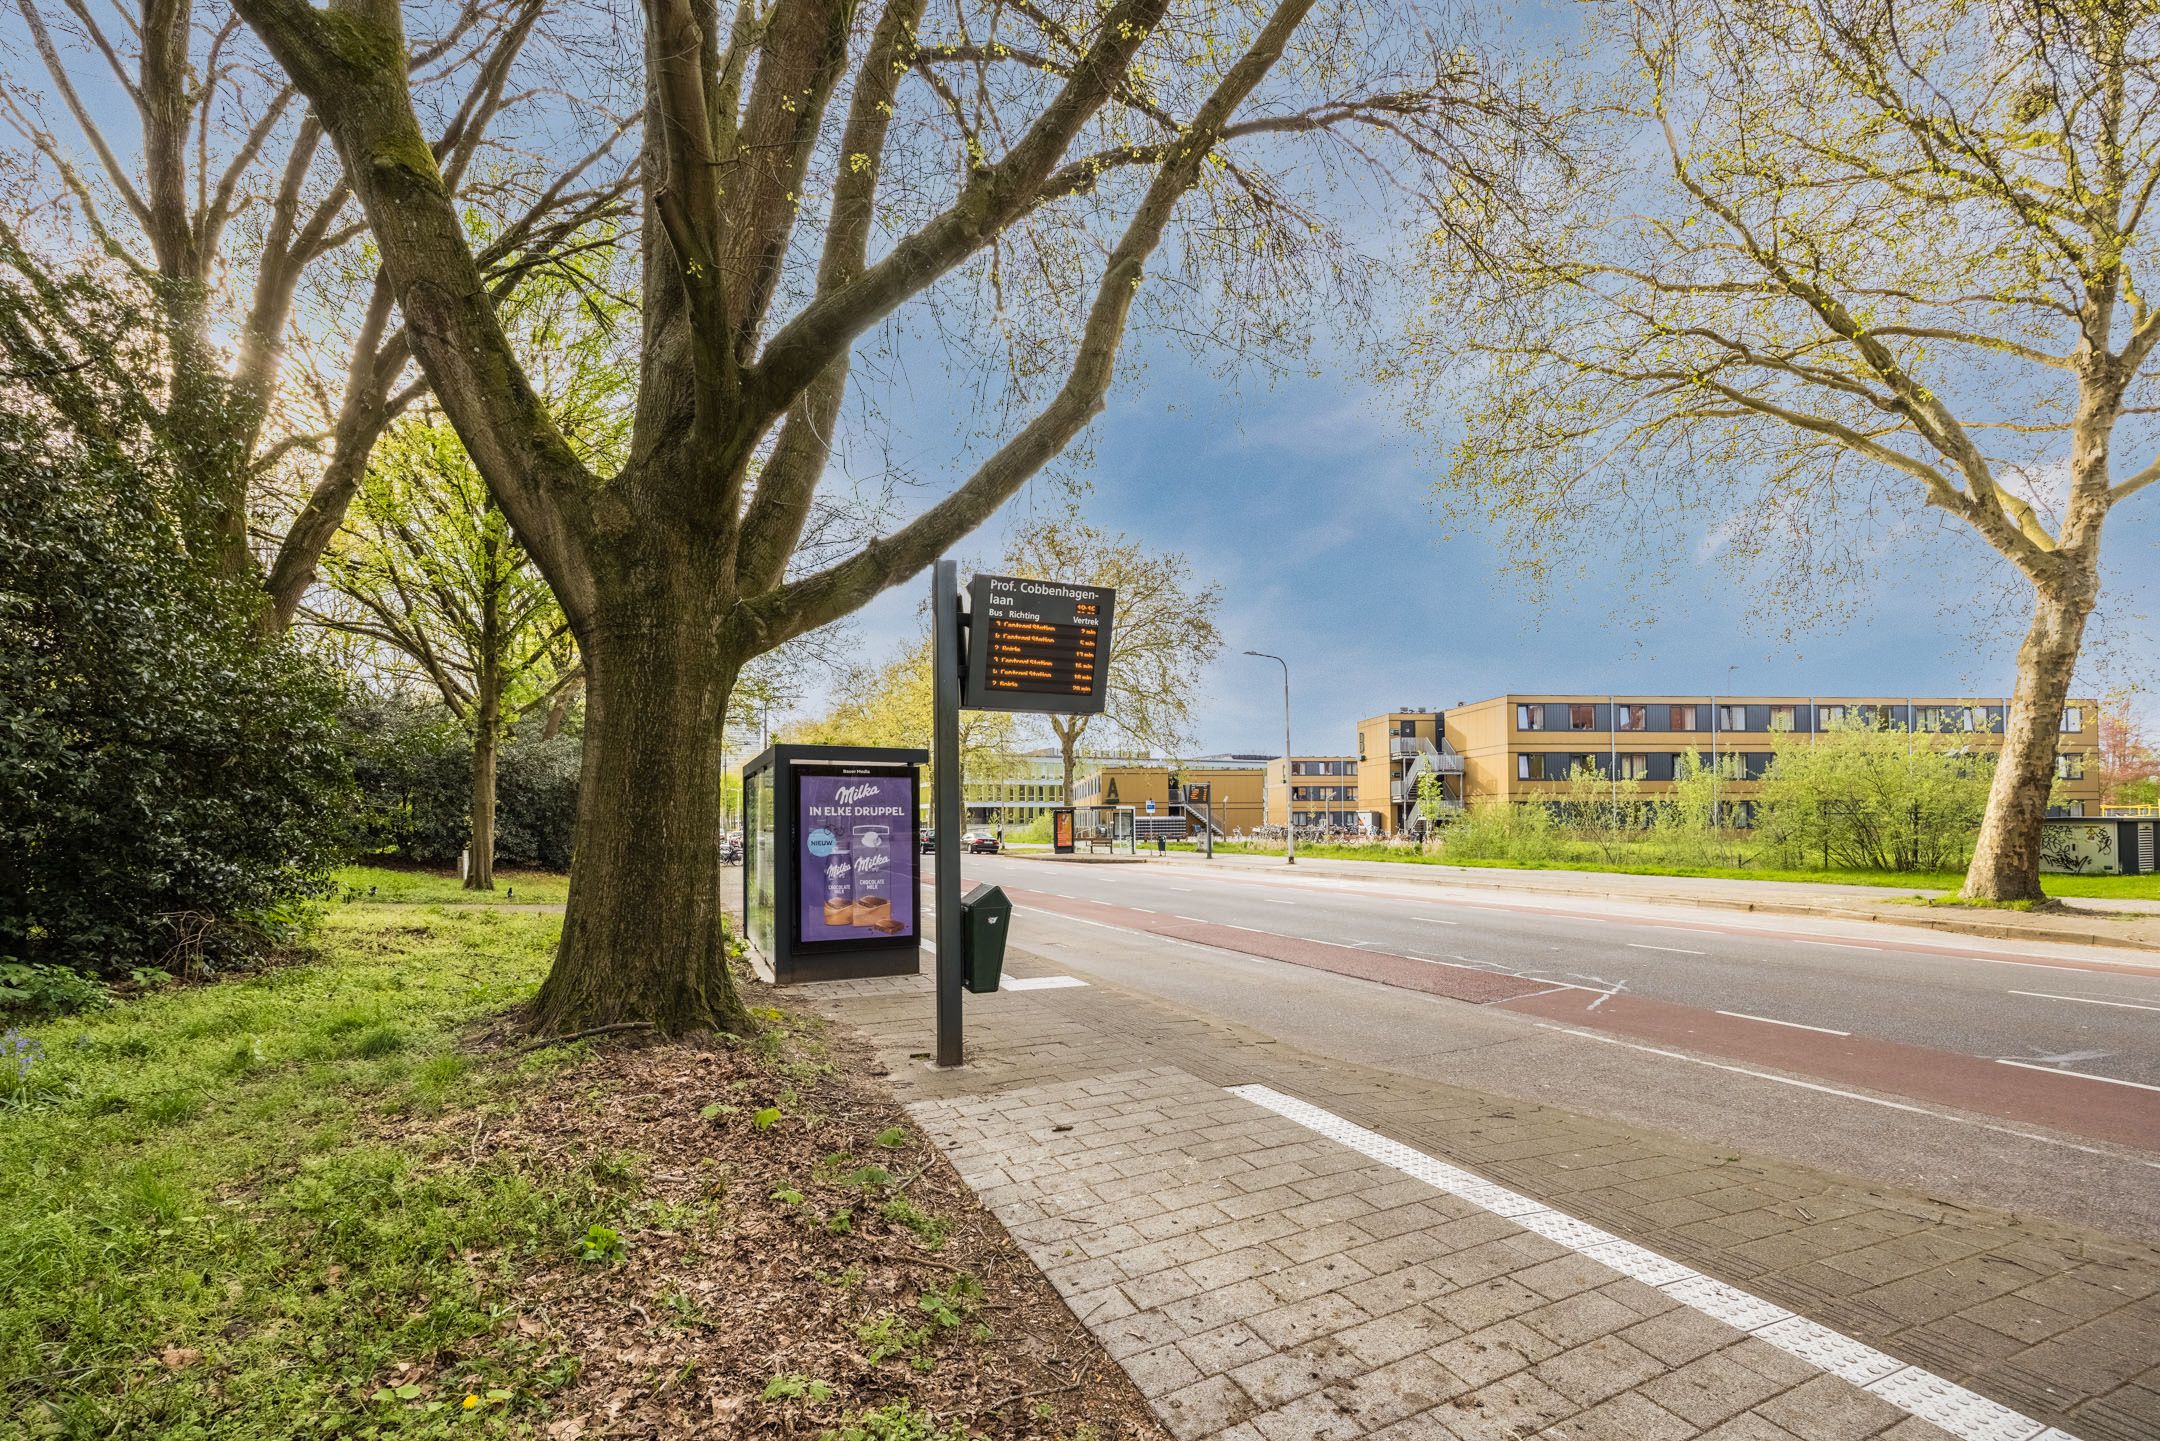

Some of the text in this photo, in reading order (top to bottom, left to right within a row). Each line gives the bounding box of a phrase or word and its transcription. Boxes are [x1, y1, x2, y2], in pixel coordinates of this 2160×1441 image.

[990, 579, 1100, 600] Prof. Cobbenhagen-
[989, 593, 1014, 606] laan
[989, 608, 1040, 622] Bus Richting
[1073, 616, 1099, 626] Vertrek
[835, 783, 880, 804] Milka
[1107, 777, 1119, 798] A
[809, 806, 905, 816] IN ELKE DRUPPEL
[826, 862, 851, 878] Milka
[854, 854, 890, 872] Milka
